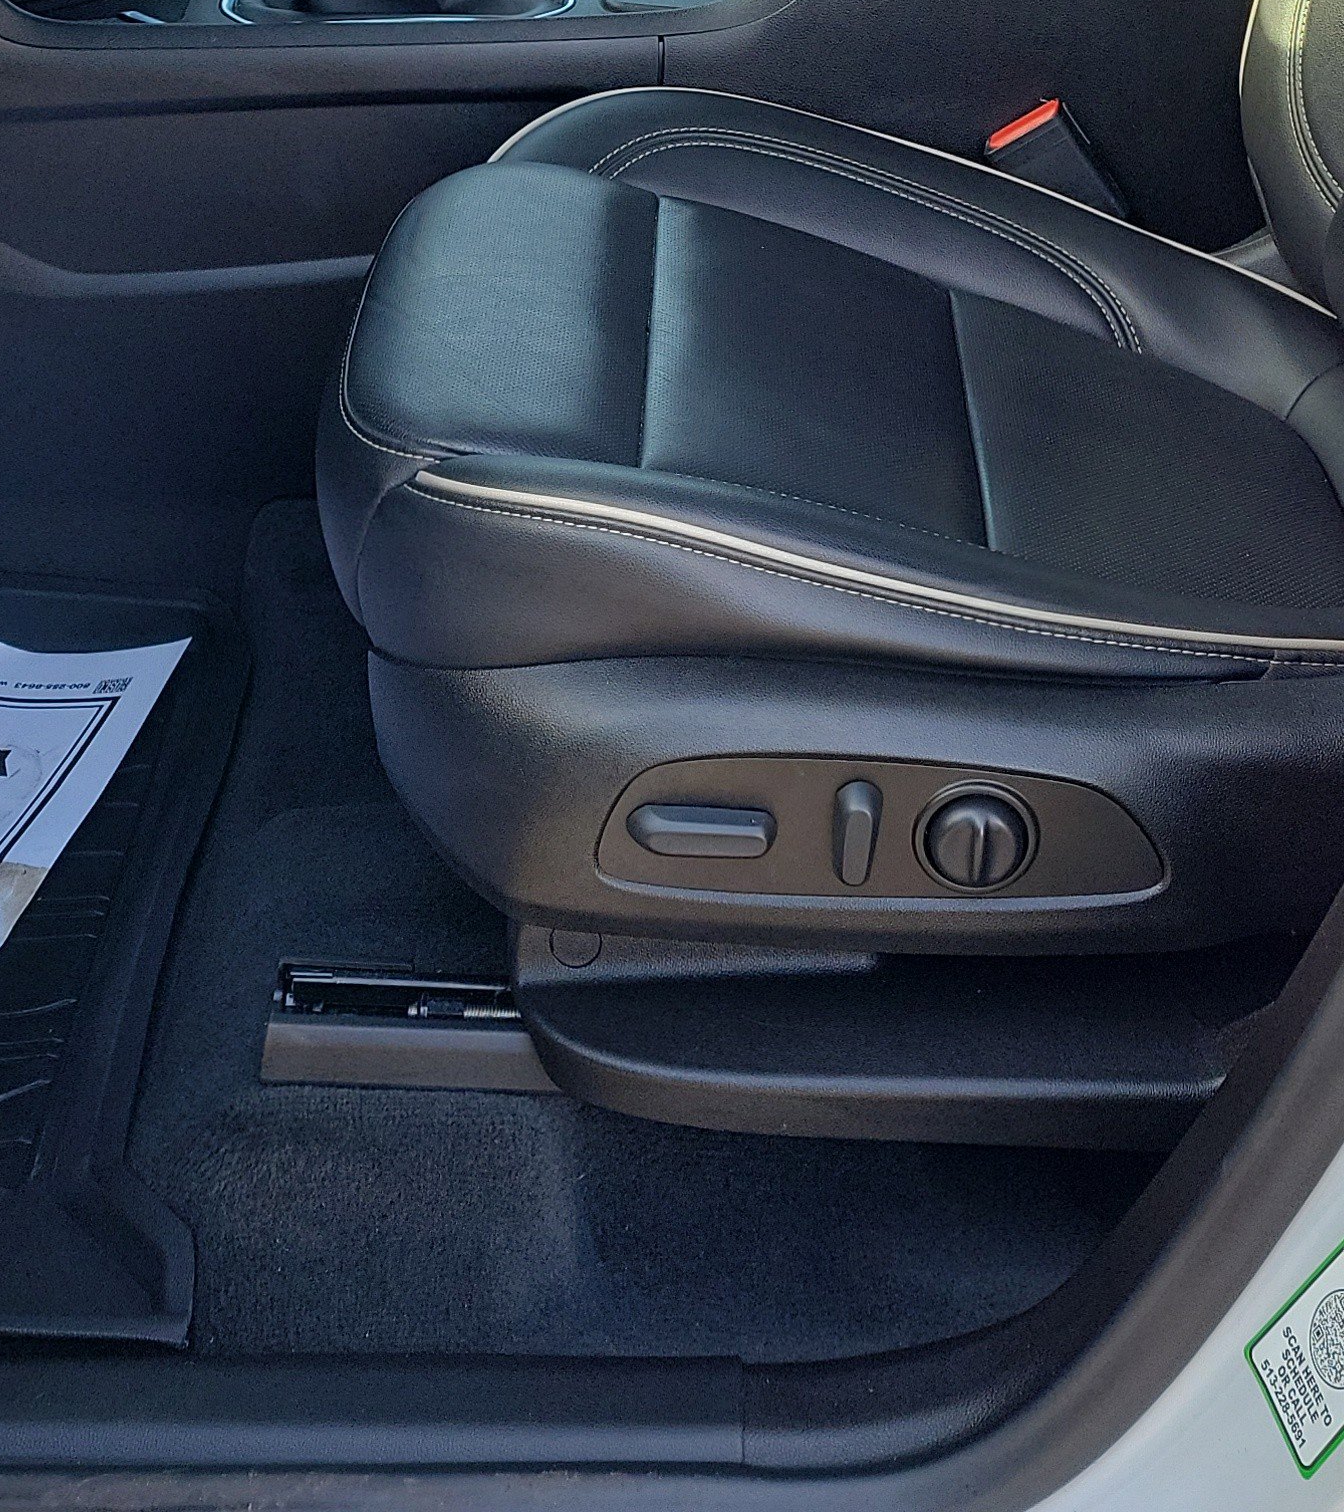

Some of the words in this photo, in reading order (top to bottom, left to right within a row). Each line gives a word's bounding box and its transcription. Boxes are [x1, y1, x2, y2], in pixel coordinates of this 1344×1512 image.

[1260, 1359, 1307, 1449] 513-228-5691
[1277, 1366, 1292, 1388] OR
[1289, 1388, 1308, 1427] CALL
[1281, 1349, 1320, 1424] SCHEDULE
[1282, 1327, 1305, 1366] SCAN
[1304, 1366, 1325, 1407] HERE
[1322, 1405, 1333, 1427] TO
